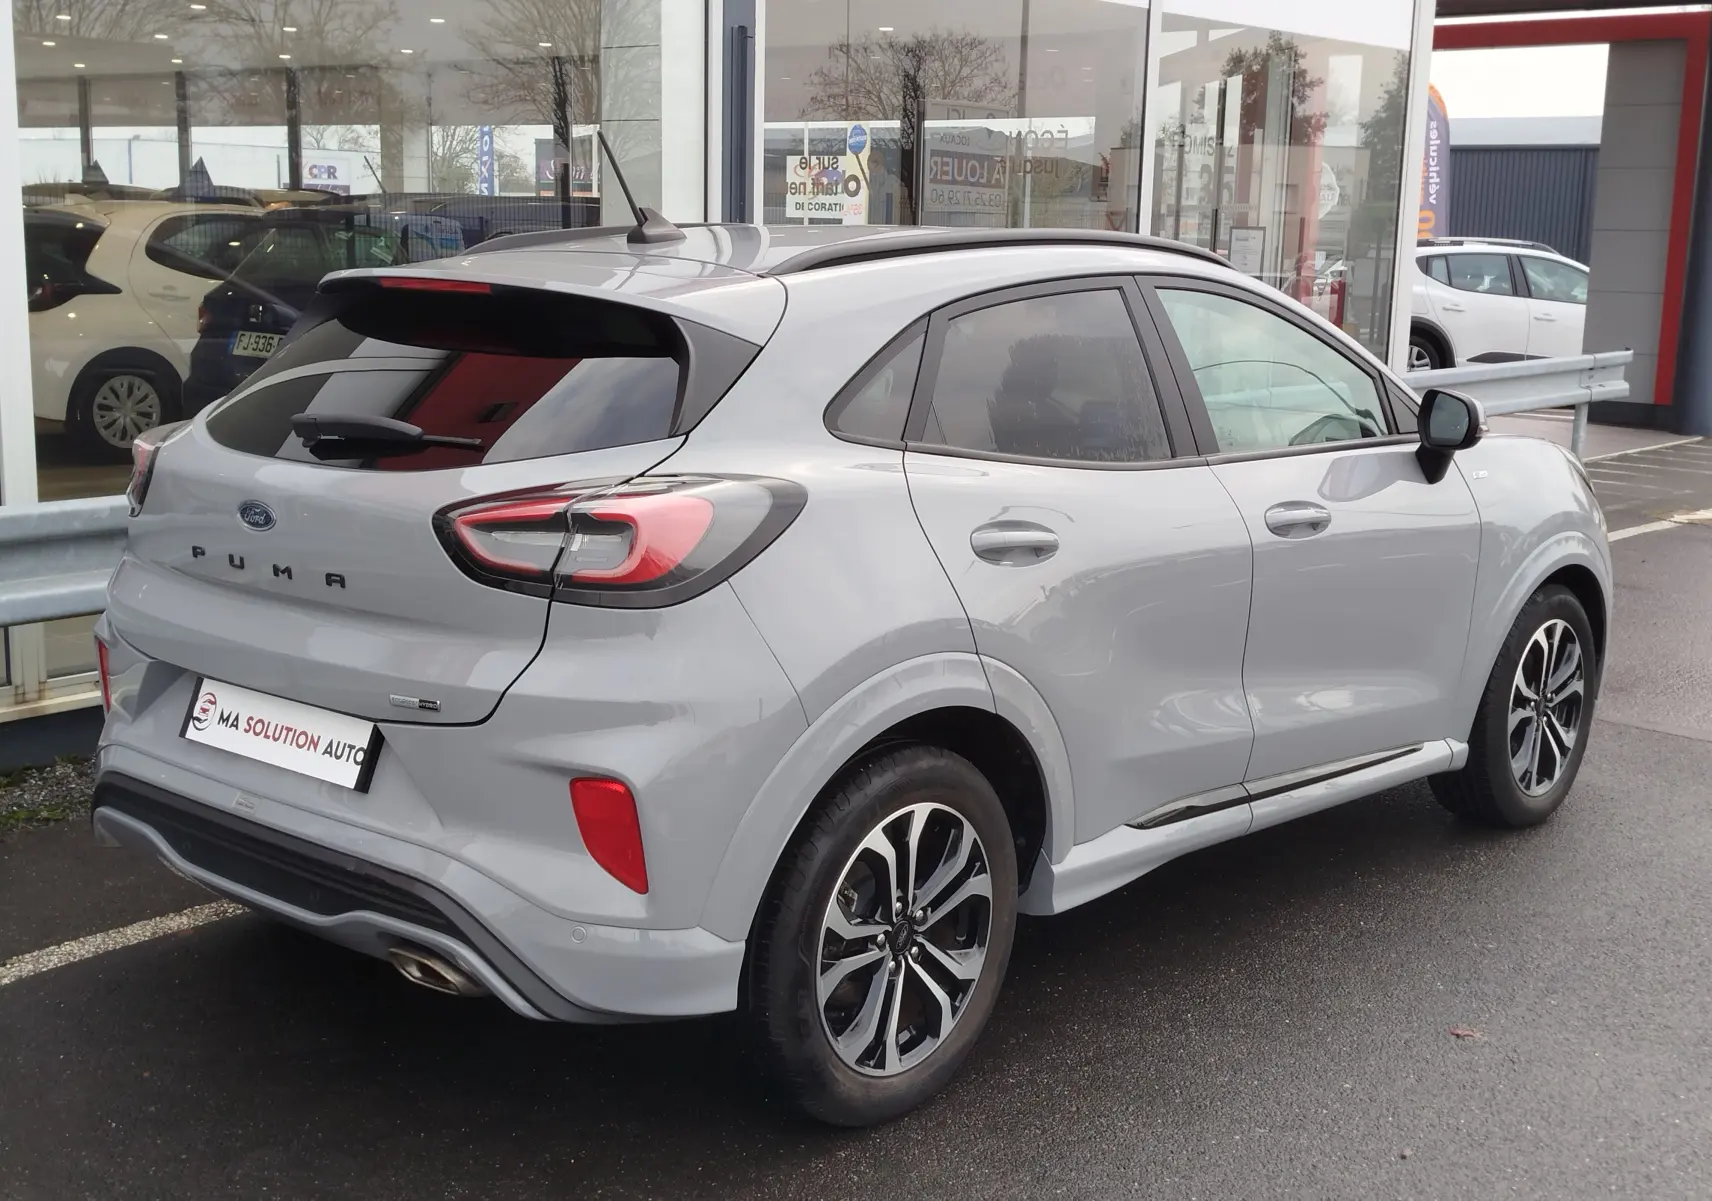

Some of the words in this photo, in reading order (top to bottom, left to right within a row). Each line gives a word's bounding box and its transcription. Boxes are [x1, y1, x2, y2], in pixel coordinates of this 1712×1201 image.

[308, 164, 338, 180] CPR
[244, 507, 266, 525] Ford
[191, 545, 346, 589] PUMA
[217, 708, 240, 731] MA
[243, 715, 322, 753] SOLUTION
